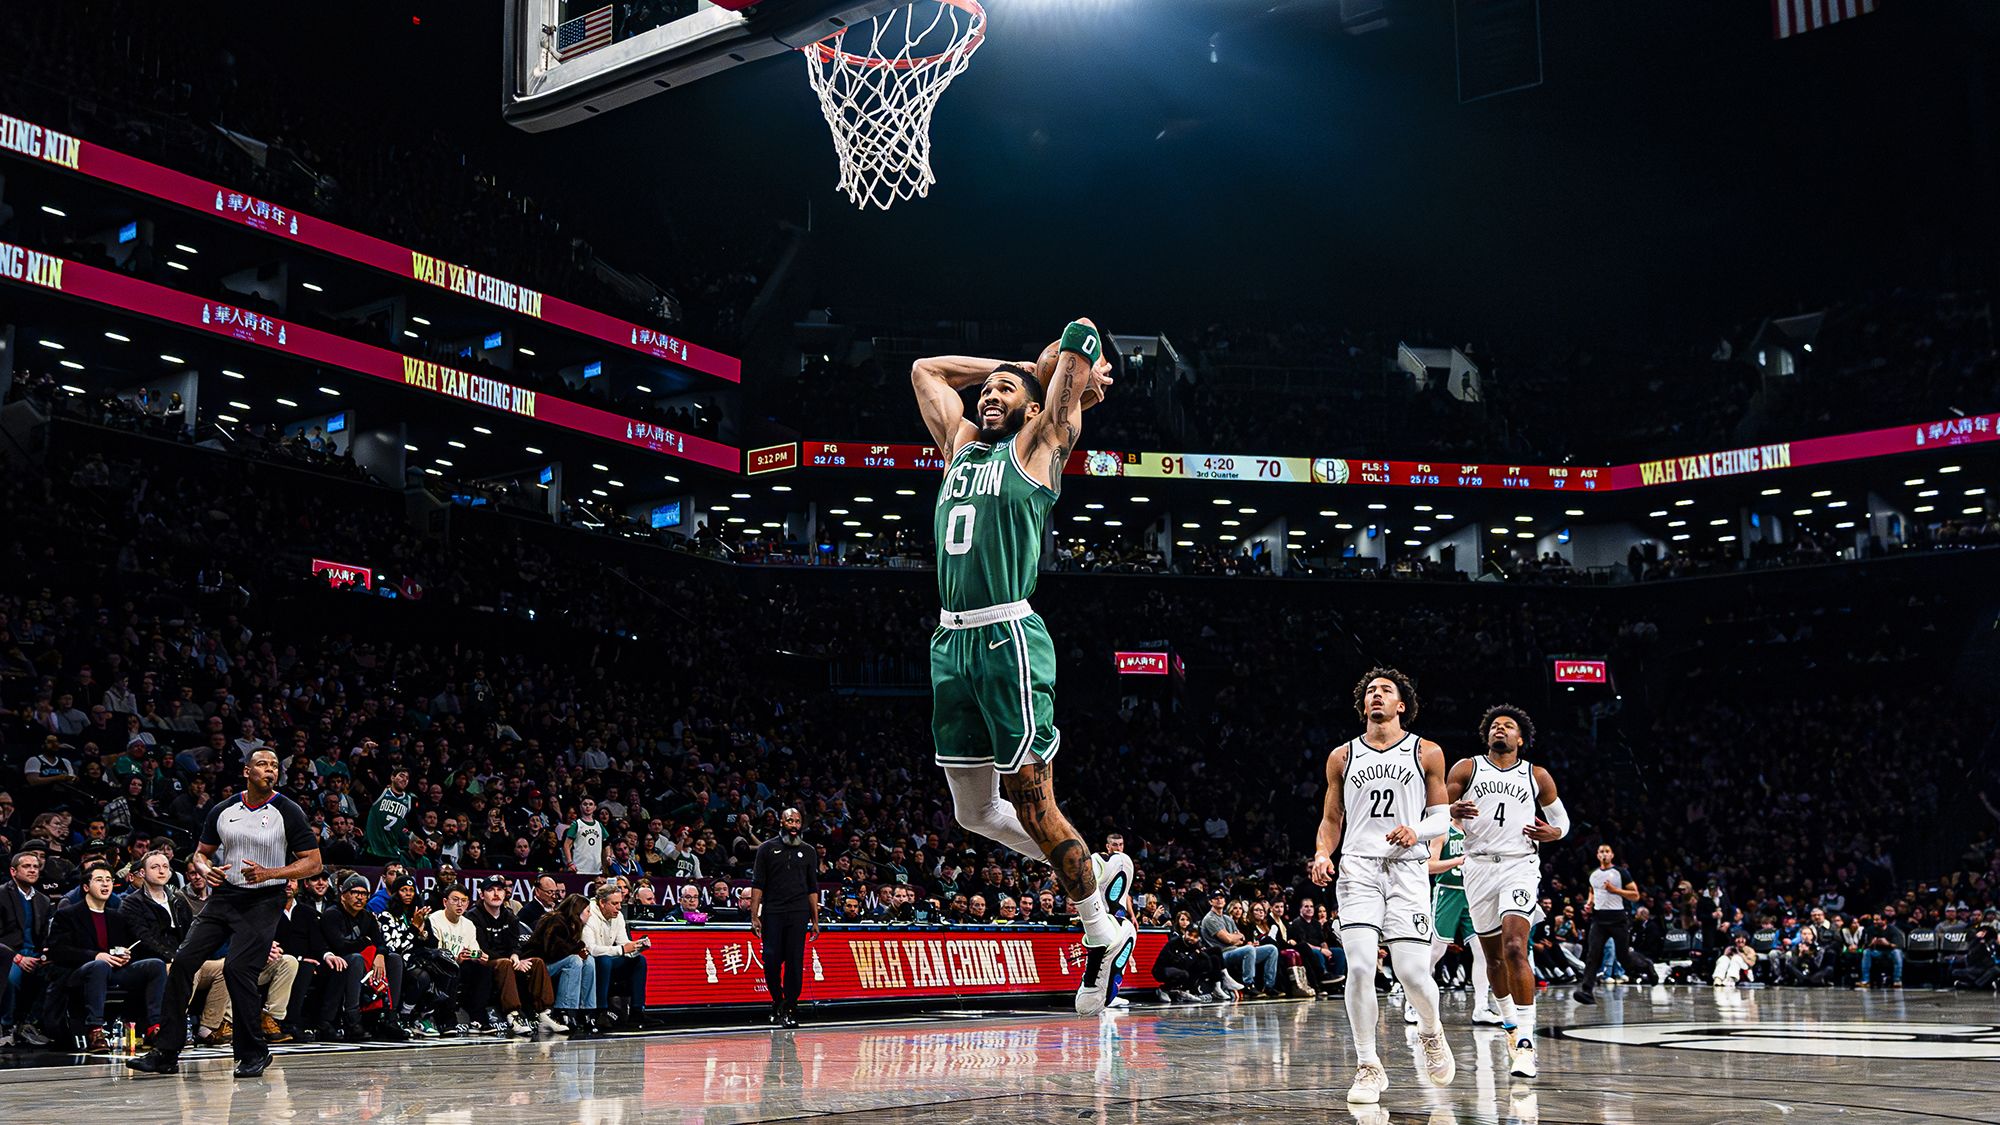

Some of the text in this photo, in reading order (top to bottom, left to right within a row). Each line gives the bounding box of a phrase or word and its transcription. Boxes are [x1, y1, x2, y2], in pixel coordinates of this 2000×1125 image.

[43, 129, 81, 169] NIN
[26, 250, 63, 290] NIN
[411, 251, 543, 319] WAH YAN CHING NIN
[1081, 334, 1097, 355] 0
[402, 355, 536, 417] WAH YAN CHING NIN
[823, 444, 838, 453] FG
[870, 446, 889, 455] 3PT
[922, 447, 935, 456] FT
[757, 451, 788, 466] 9:12 PM
[1128, 453, 1137, 463] B
[1161, 456, 1184, 475] 91
[1203, 458, 1235, 471] 4:20
[1362, 462, 1382, 471] FLS:
[1639, 443, 1790, 486] WAH YAN CHING NIN
[1196, 470, 1239, 480] 3rd Quarter
[1256, 460, 1282, 478] 70
[1417, 464, 1431, 473] FG
[1461, 465, 1478, 475] 3PT
[1509, 466, 1520, 476] FT
[1549, 468, 1568, 477] REB
[1580, 469, 1598, 478] AST
[1361, 473, 1390, 483] TOL: 3
[944, 503, 977, 556] 0
[1350, 764, 1415, 789] BROOKLYN
[1473, 781, 1529, 804] BROOKLYN
[379, 798, 409, 820] BOSTON
[1370, 789, 1395, 818] 22
[383, 814, 399, 832] 7
[1494, 803, 1506, 828] 4
[588, 837, 596, 847] 0
[720, 941, 765, 975] 華人
[847, 940, 907, 988] WAH
[902, 940, 951, 987] YAN
[944, 939, 1007, 987] CHING
[1001, 939, 1041, 985] NIN
